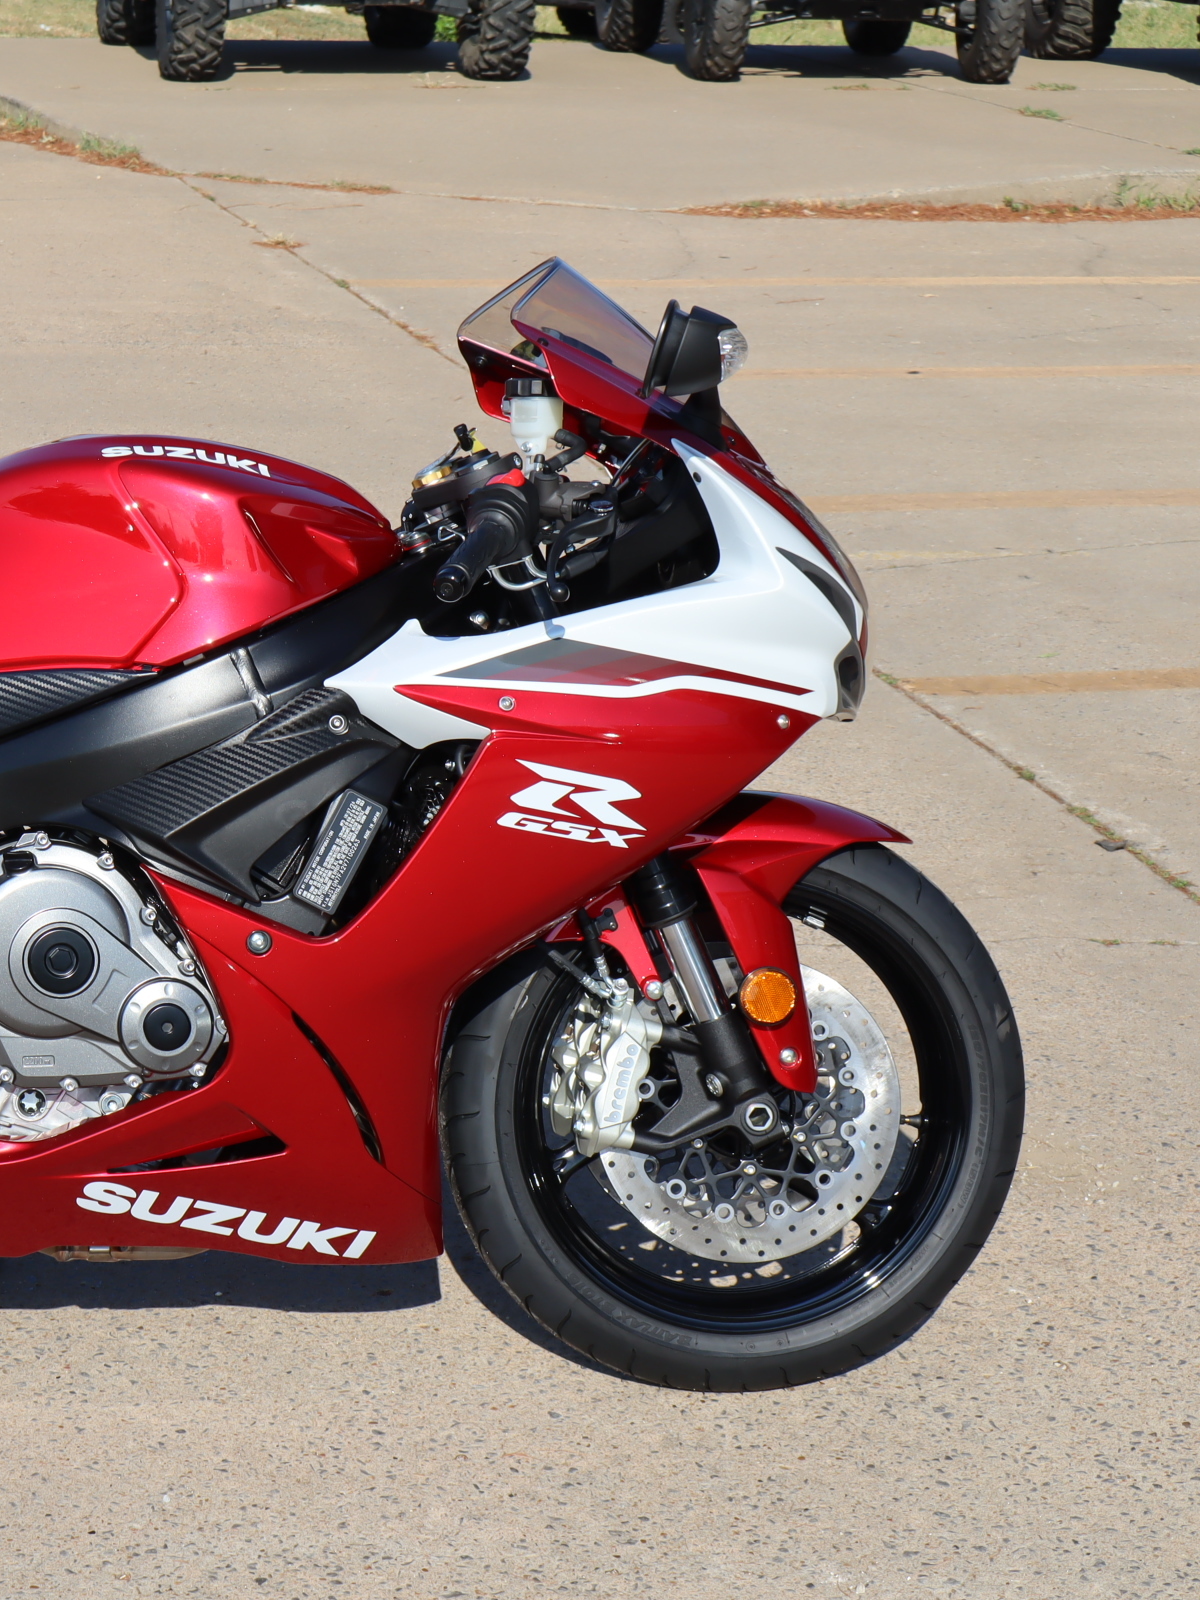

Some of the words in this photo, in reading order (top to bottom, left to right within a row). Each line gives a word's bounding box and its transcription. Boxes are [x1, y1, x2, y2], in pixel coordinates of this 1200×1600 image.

[101, 445, 271, 477] SUZUKI
[497, 812, 645, 848] GSX
[510, 759, 647, 831] R
[604, 1044, 637, 1122] brembo
[76, 1181, 377, 1259] SUZUKI
